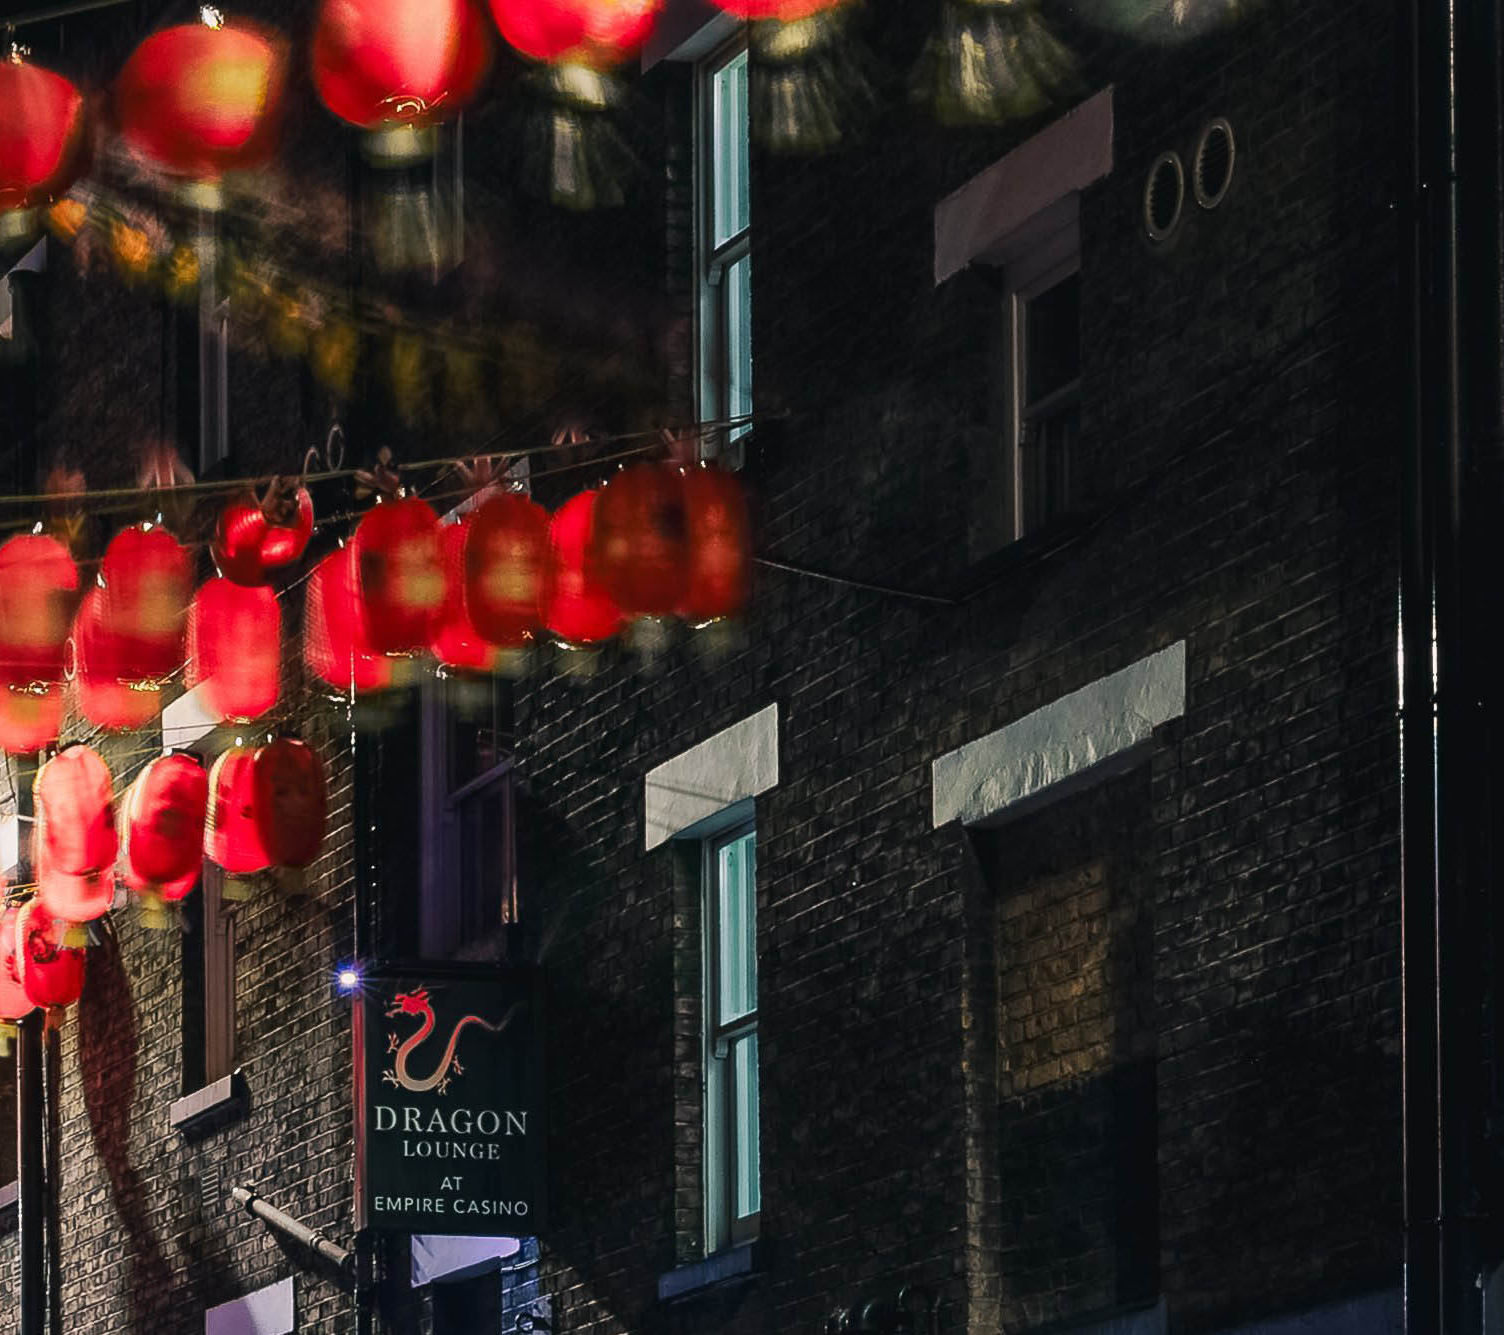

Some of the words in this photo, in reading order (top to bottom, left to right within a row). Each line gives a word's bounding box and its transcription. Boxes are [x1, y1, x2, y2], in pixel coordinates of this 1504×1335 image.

[374, 1105, 528, 1136] DRAGON
[403, 1140, 501, 1160] LOUNGE
[440, 1176, 463, 1191] AT
[374, 1196, 446, 1213] EMPIRE
[453, 1199, 529, 1216] CASINO
